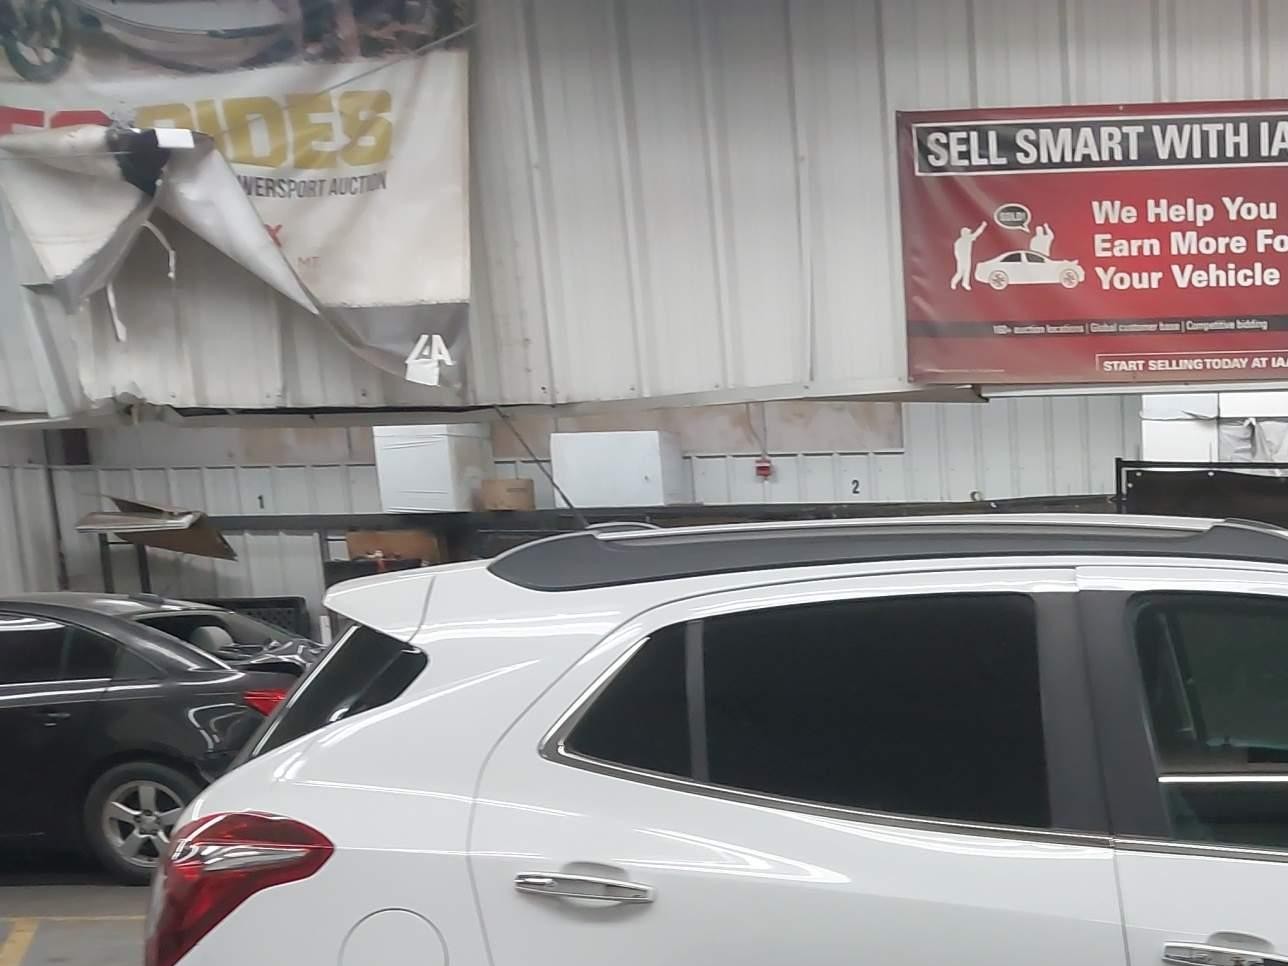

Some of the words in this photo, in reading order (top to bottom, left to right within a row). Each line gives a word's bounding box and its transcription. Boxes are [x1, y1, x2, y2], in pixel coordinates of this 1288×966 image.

[927, 130, 1007, 167] SELL
[1015, 126, 1144, 164] SMART
[1152, 122, 1249, 160] WITH
[237, 175, 326, 198] WERSPORT
[329, 170, 387, 195] AUCTION
[1092, 200, 1137, 224] We
[1147, 198, 1215, 227] Help
[1222, 196, 1277, 221] You
[1094, 233, 1161, 257] Earn
[1170, 231, 1247, 255] More
[1095, 266, 1163, 290] Your
[1171, 262, 1280, 288] Vehicle
[1103, 361, 1146, 372] START
[1148, 359, 1204, 371] SELLING
[1204, 358, 1249, 370] TODAY
[1251, 357, 1269, 369] AT
[851, 480, 860, 494] 2
[257, 494, 264, 509] 1
